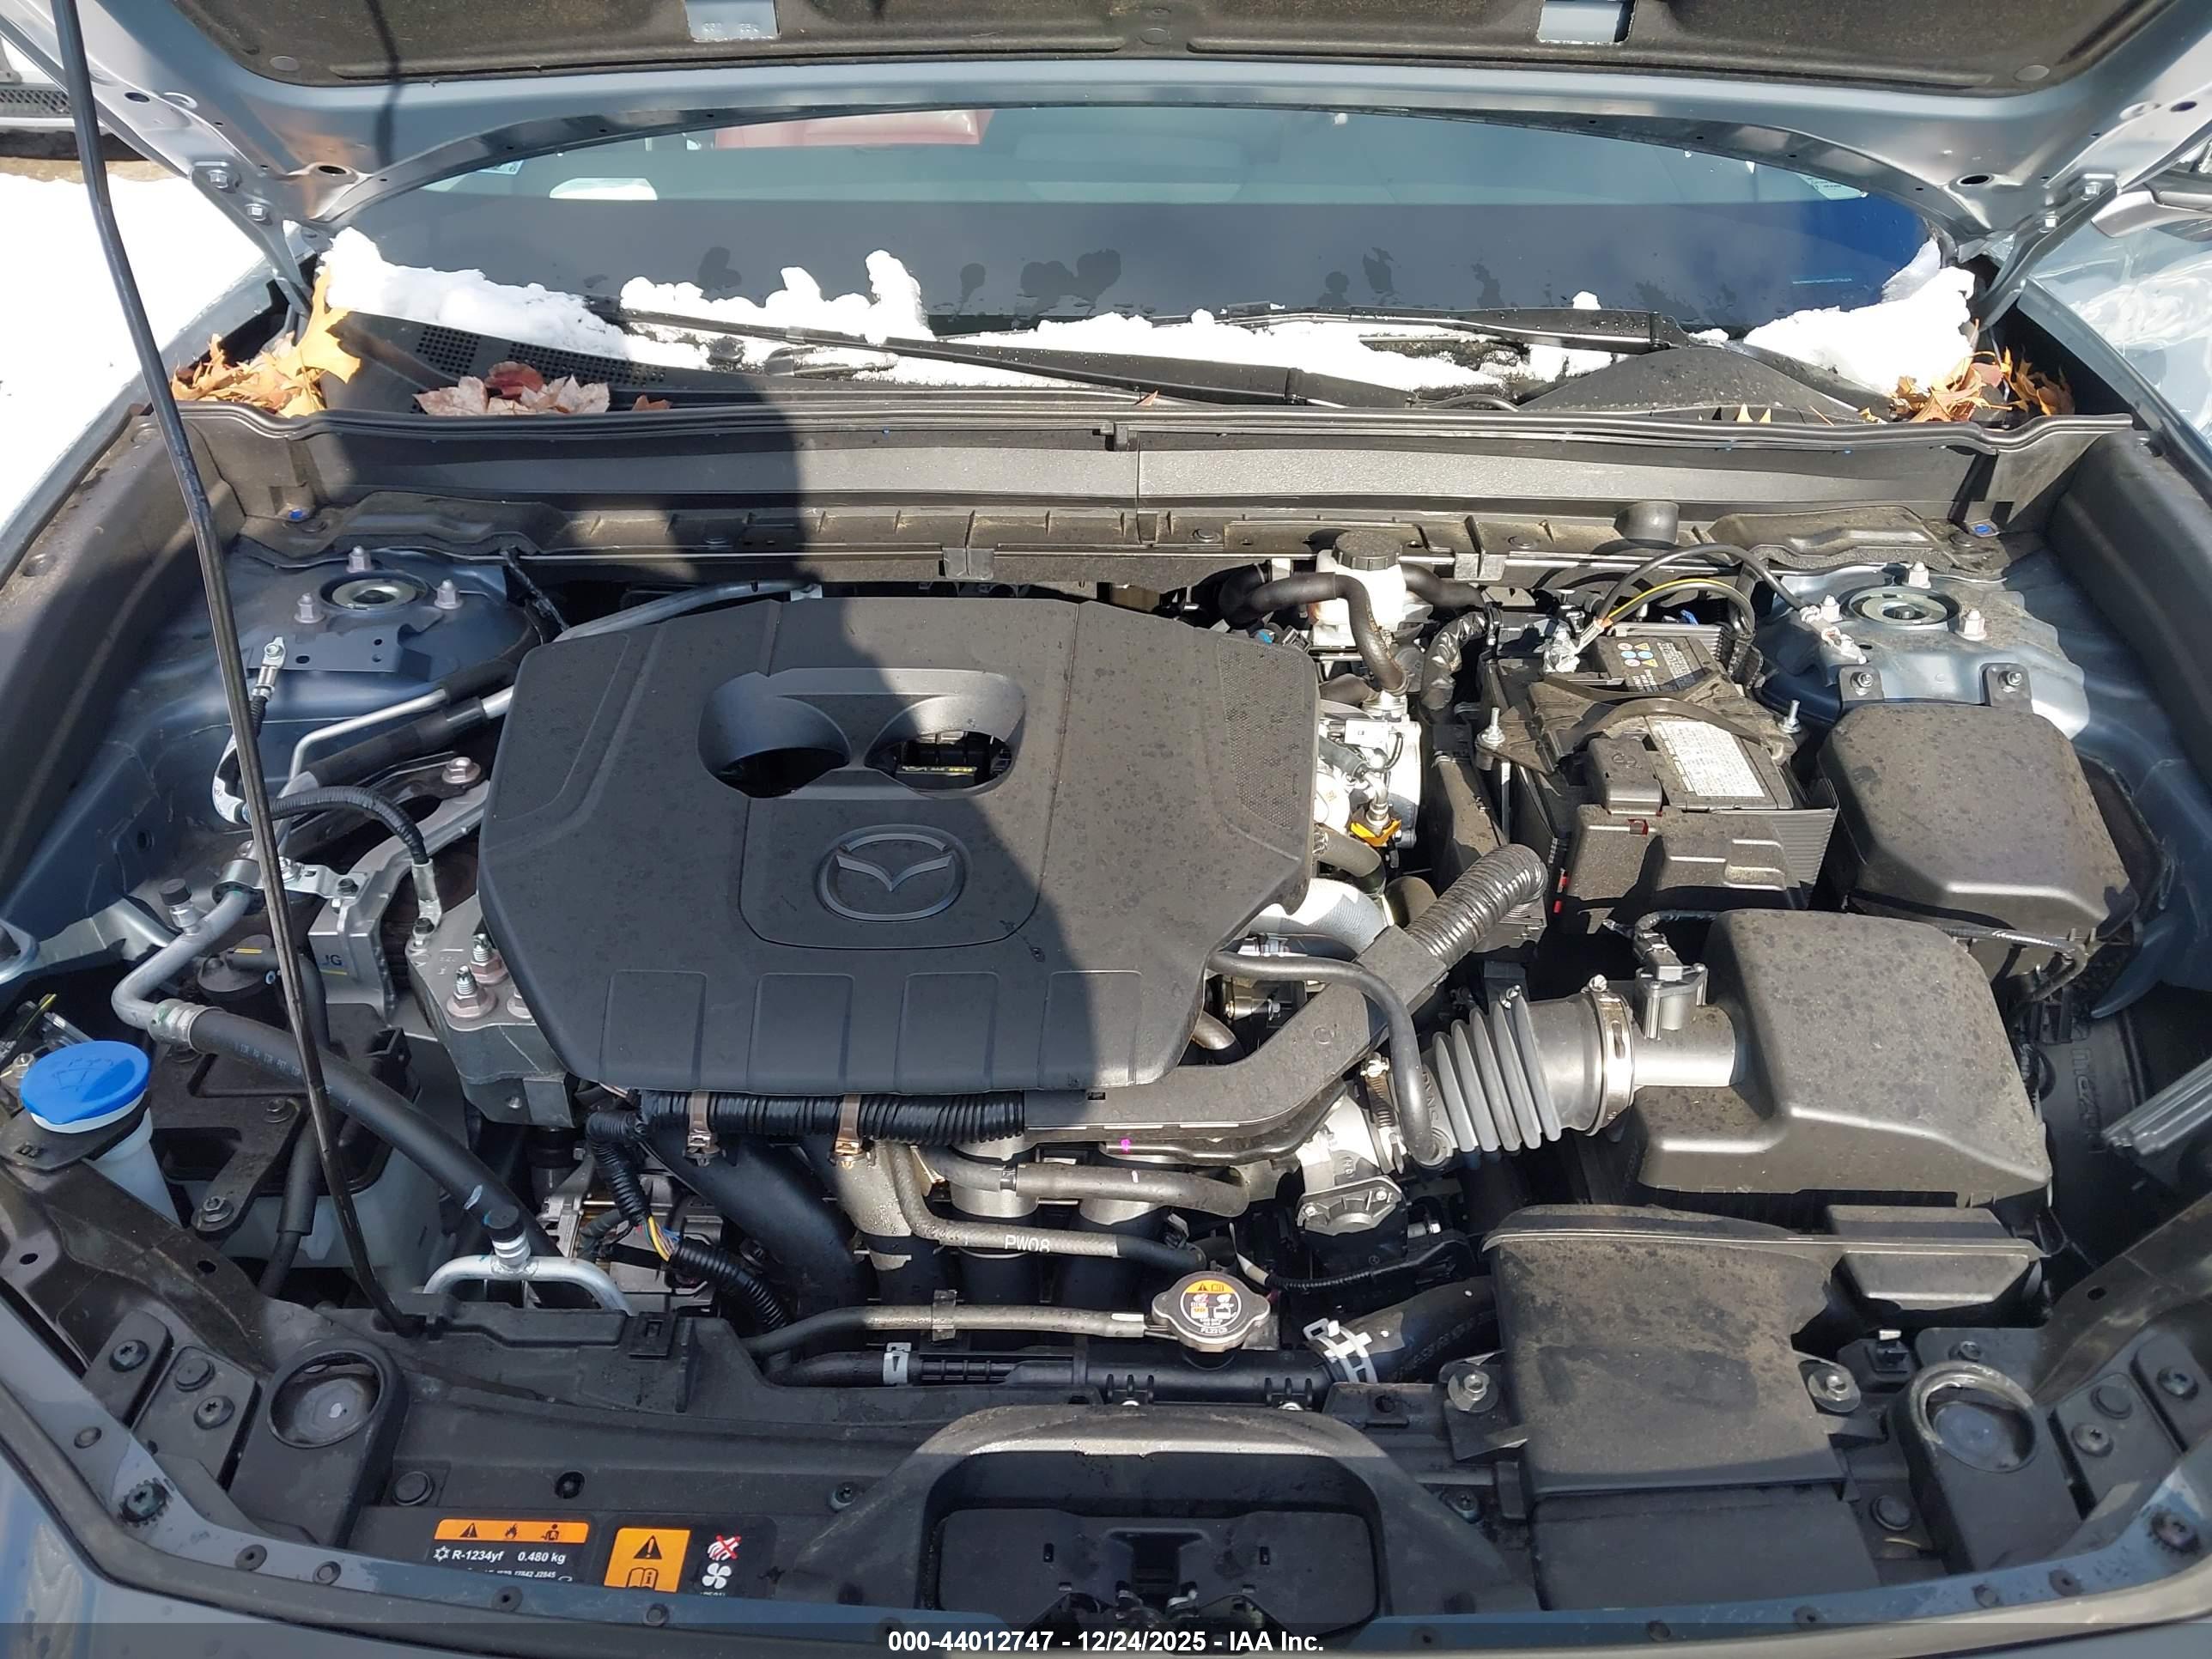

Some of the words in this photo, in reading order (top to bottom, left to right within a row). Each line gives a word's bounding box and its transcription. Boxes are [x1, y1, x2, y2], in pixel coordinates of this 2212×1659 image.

[1005, 1234, 1050, 1254] PW08
[452, 1549, 505, 1563] R-1234yf
[517, 1551, 550, 1562] 0.480
[550, 1552, 567, 1565] kg
